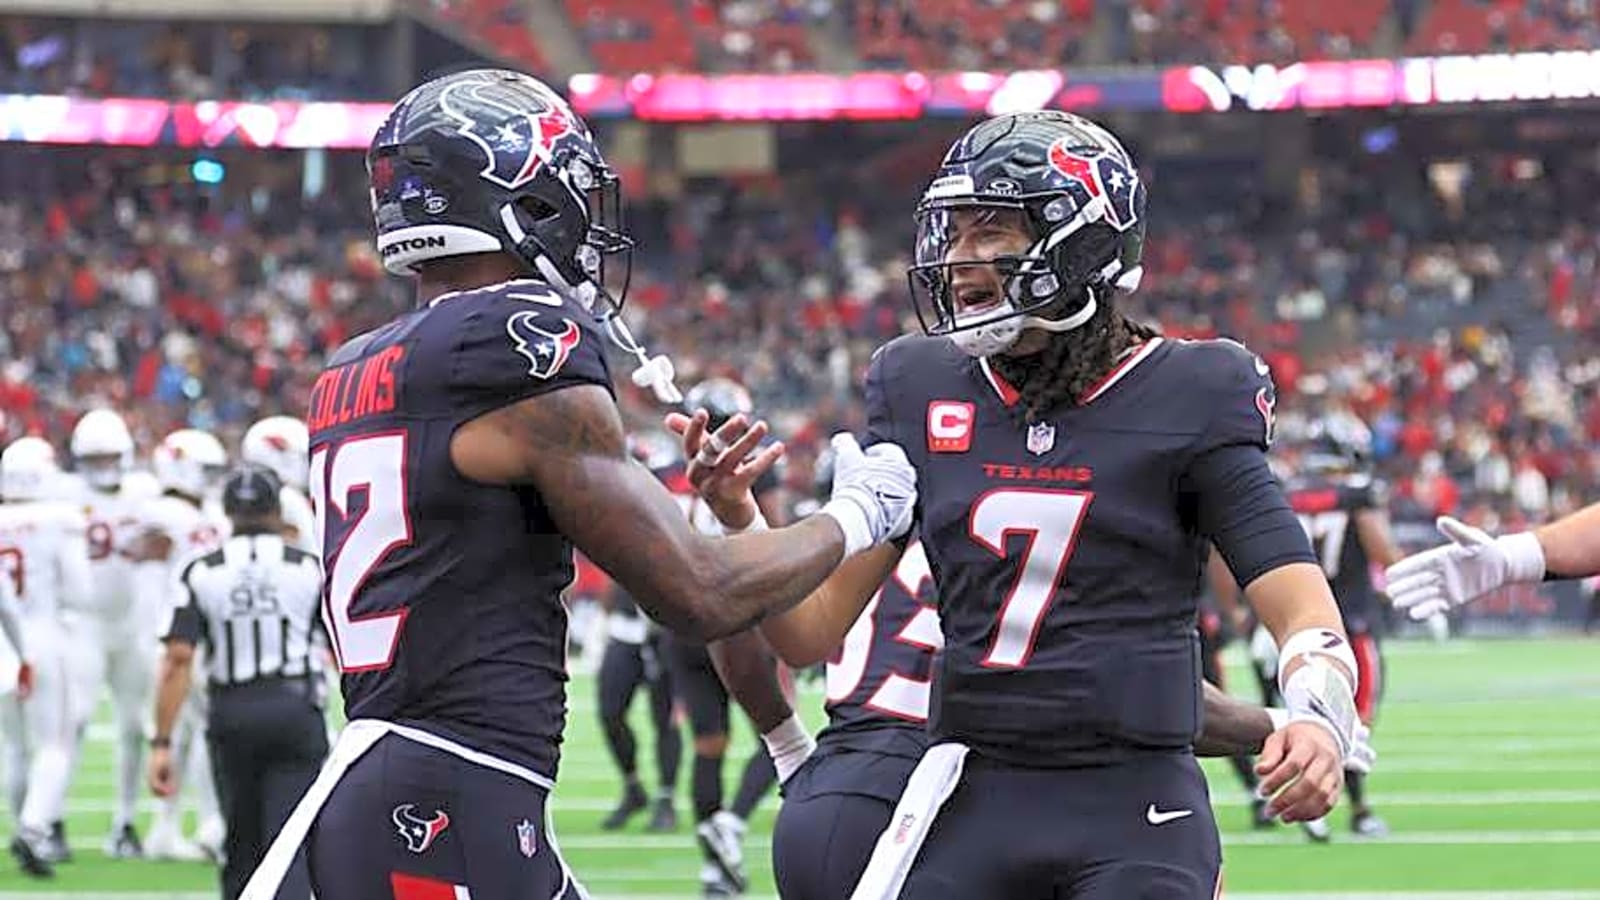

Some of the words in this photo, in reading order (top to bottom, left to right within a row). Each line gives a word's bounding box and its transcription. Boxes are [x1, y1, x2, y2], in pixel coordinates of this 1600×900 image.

[930, 404, 971, 439] C
[982, 463, 1093, 482] TEXANS
[968, 487, 1093, 668] 7
[229, 583, 280, 617] 95
